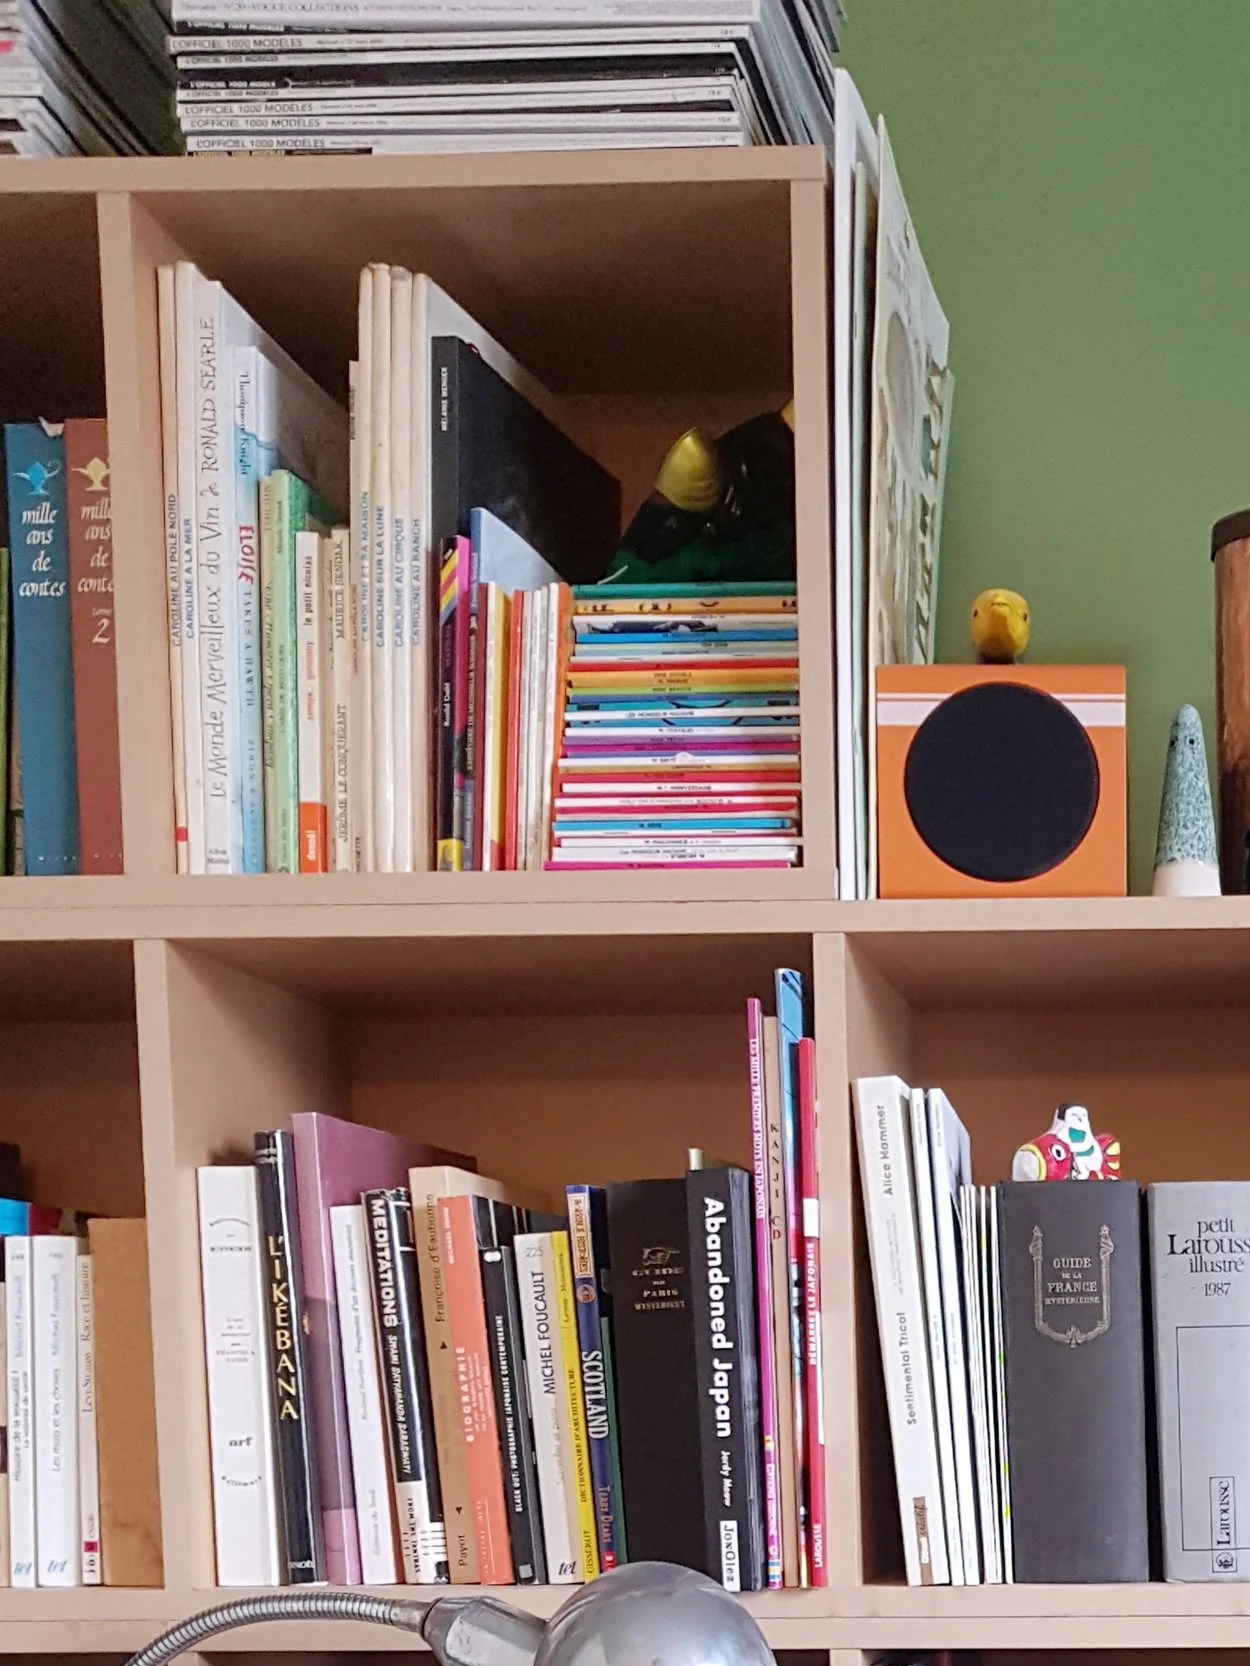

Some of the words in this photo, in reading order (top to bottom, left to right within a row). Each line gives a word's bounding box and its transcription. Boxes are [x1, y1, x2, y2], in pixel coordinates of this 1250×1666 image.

[198, 317, 218, 391] SEARLE
[201, 398, 221, 474] RONALD
[21, 502, 57, 524] mille
[198, 505, 222, 543] Vin
[374, 505, 385, 538] LUNE
[26, 527, 53, 546] ans
[375, 542, 384, 558] LA
[33, 551, 51, 571] de
[201, 551, 222, 575] du
[375, 561, 385, 587] SUR
[19, 578, 66, 597] contes
[375, 590, 386, 648] CAROLINE
[201, 586, 227, 704] Merveilleux
[206, 710, 228, 777] Monde
[210, 781, 227, 799] Le
[874, 1104, 892, 1159] Hammer
[879, 1162, 894, 1196] Alice
[1197, 1218, 1236, 1235] petit
[371, 1199, 398, 1327] MEDITATIONS
[702, 1197, 733, 1349] Abandoned
[1053, 1257, 1092, 1269] GUIDE
[1188, 1256, 1245, 1274] illustré
[1047, 1281, 1097, 1293] FRANCE
[1203, 1282, 1232, 1297] 1987
[530, 1270, 554, 1342] FOUCAULT
[895, 1311, 911, 1347] Tricot
[540, 1344, 558, 1395] MICHEL
[898, 1349, 916, 1425] Sentimental
[581, 1349, 608, 1439] SCOTLAND
[708, 1357, 734, 1437] Japan
[1216, 1480, 1231, 1546] Larousse
